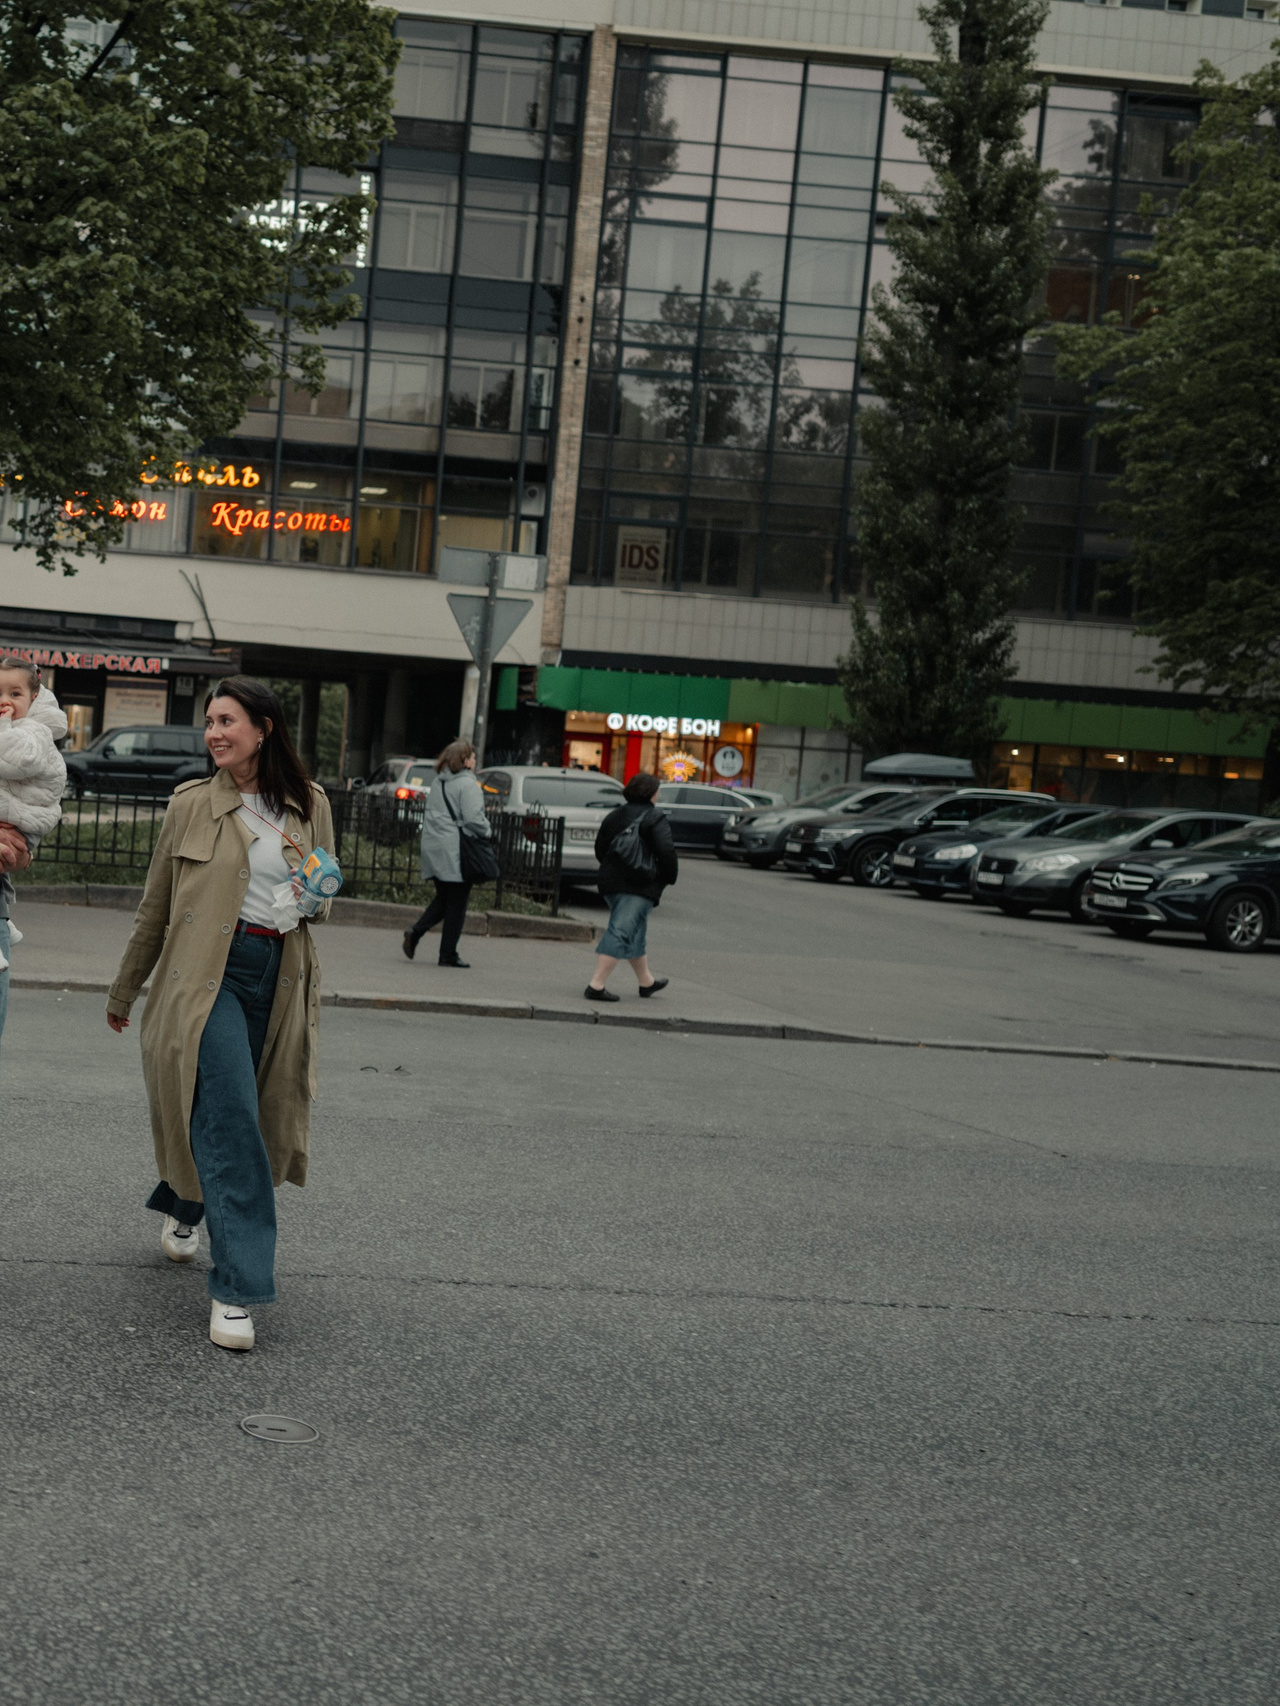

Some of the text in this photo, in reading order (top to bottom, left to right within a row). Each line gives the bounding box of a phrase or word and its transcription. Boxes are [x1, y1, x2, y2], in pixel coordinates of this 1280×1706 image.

[211, 502, 350, 536] Красоты
[621, 544, 660, 571] IDS
[626, 714, 720, 737] КОФЕ БОН
